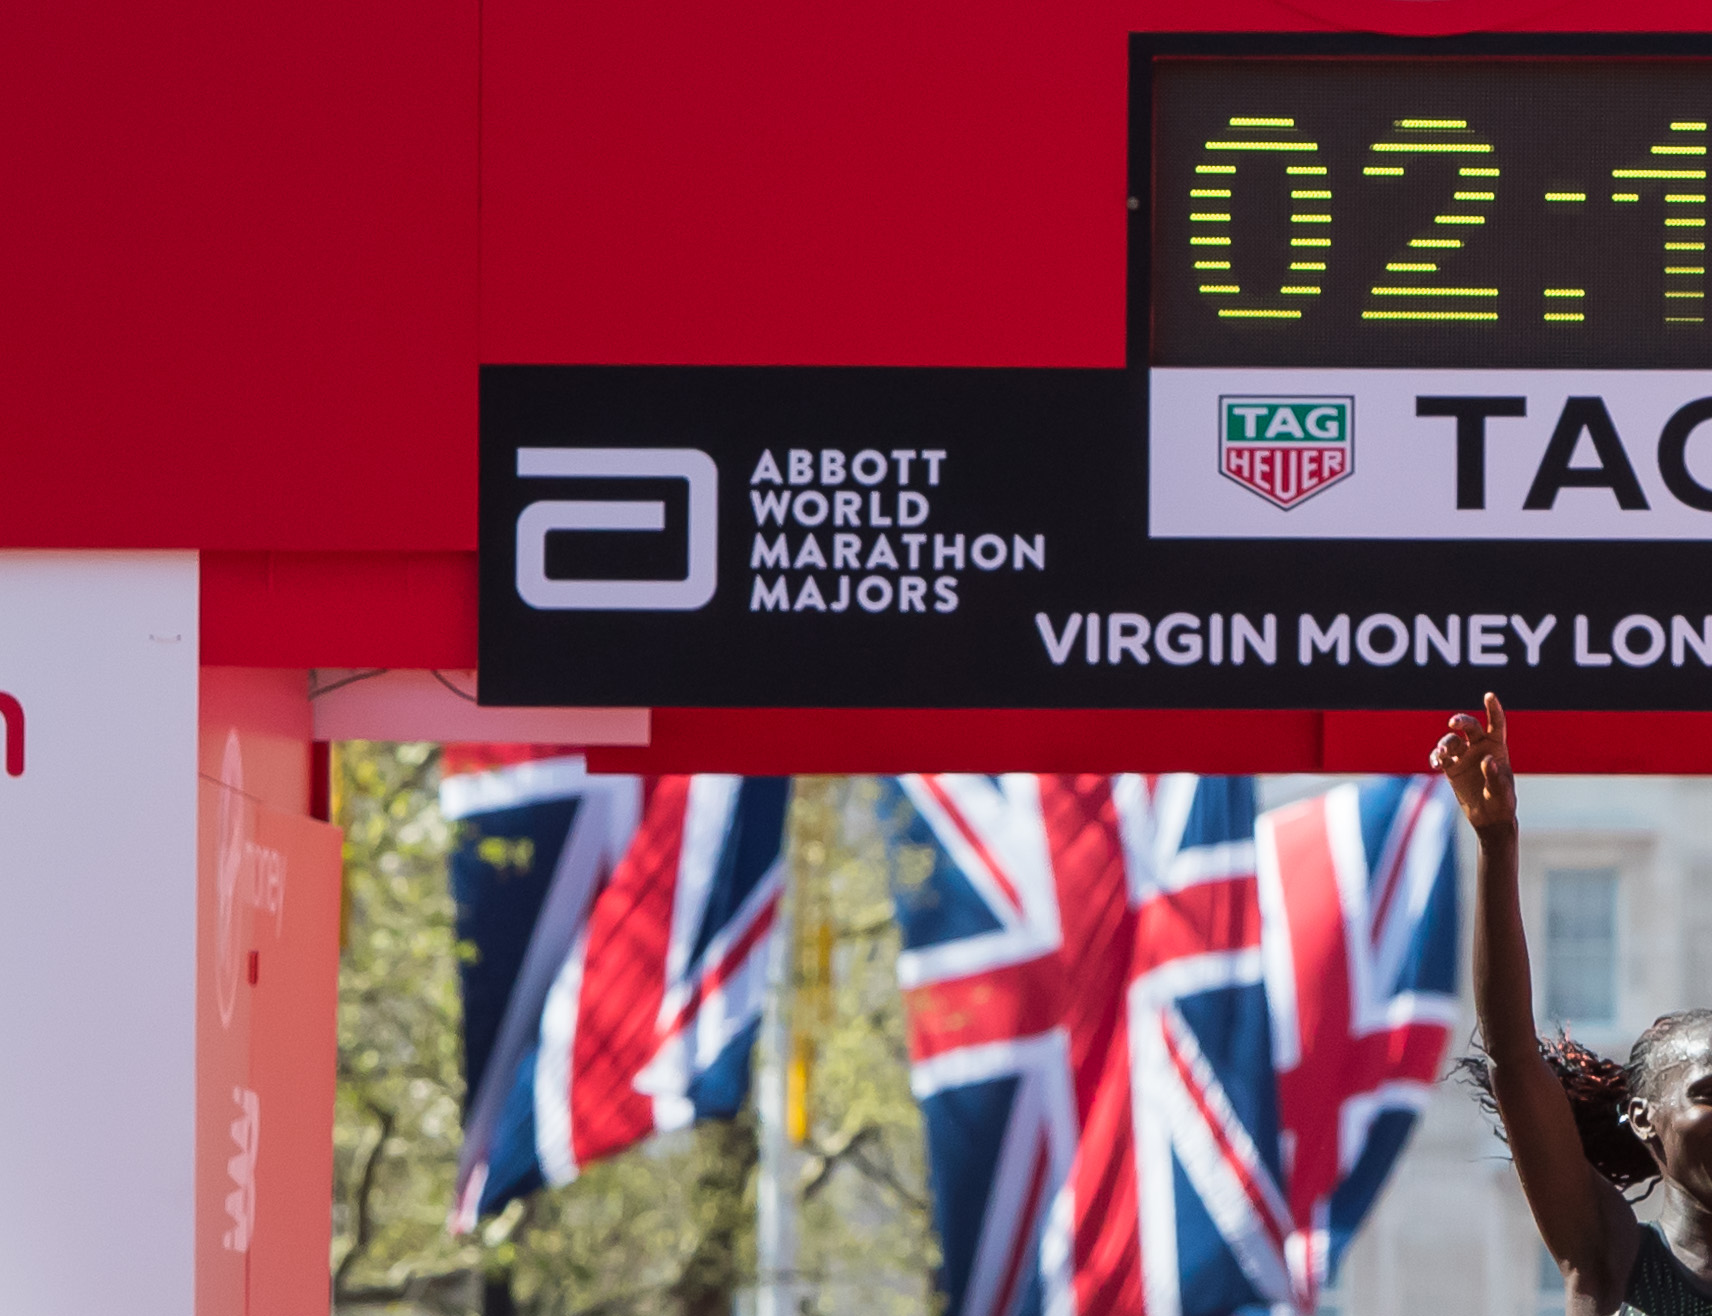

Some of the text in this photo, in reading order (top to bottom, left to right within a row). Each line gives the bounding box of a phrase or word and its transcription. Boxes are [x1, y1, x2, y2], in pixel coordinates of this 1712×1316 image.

[1232, 406, 1340, 439] TAG
[749, 448, 948, 486] ABBOTT
[1228, 449, 1344, 500] HEUER
[749, 490, 930, 527] WORLD
[749, 533, 1046, 571] MARATHON
[749, 575, 960, 613] MAJORS
[1034, 612, 1278, 666] VIRGIN
[1298, 613, 1558, 667] MONEY
